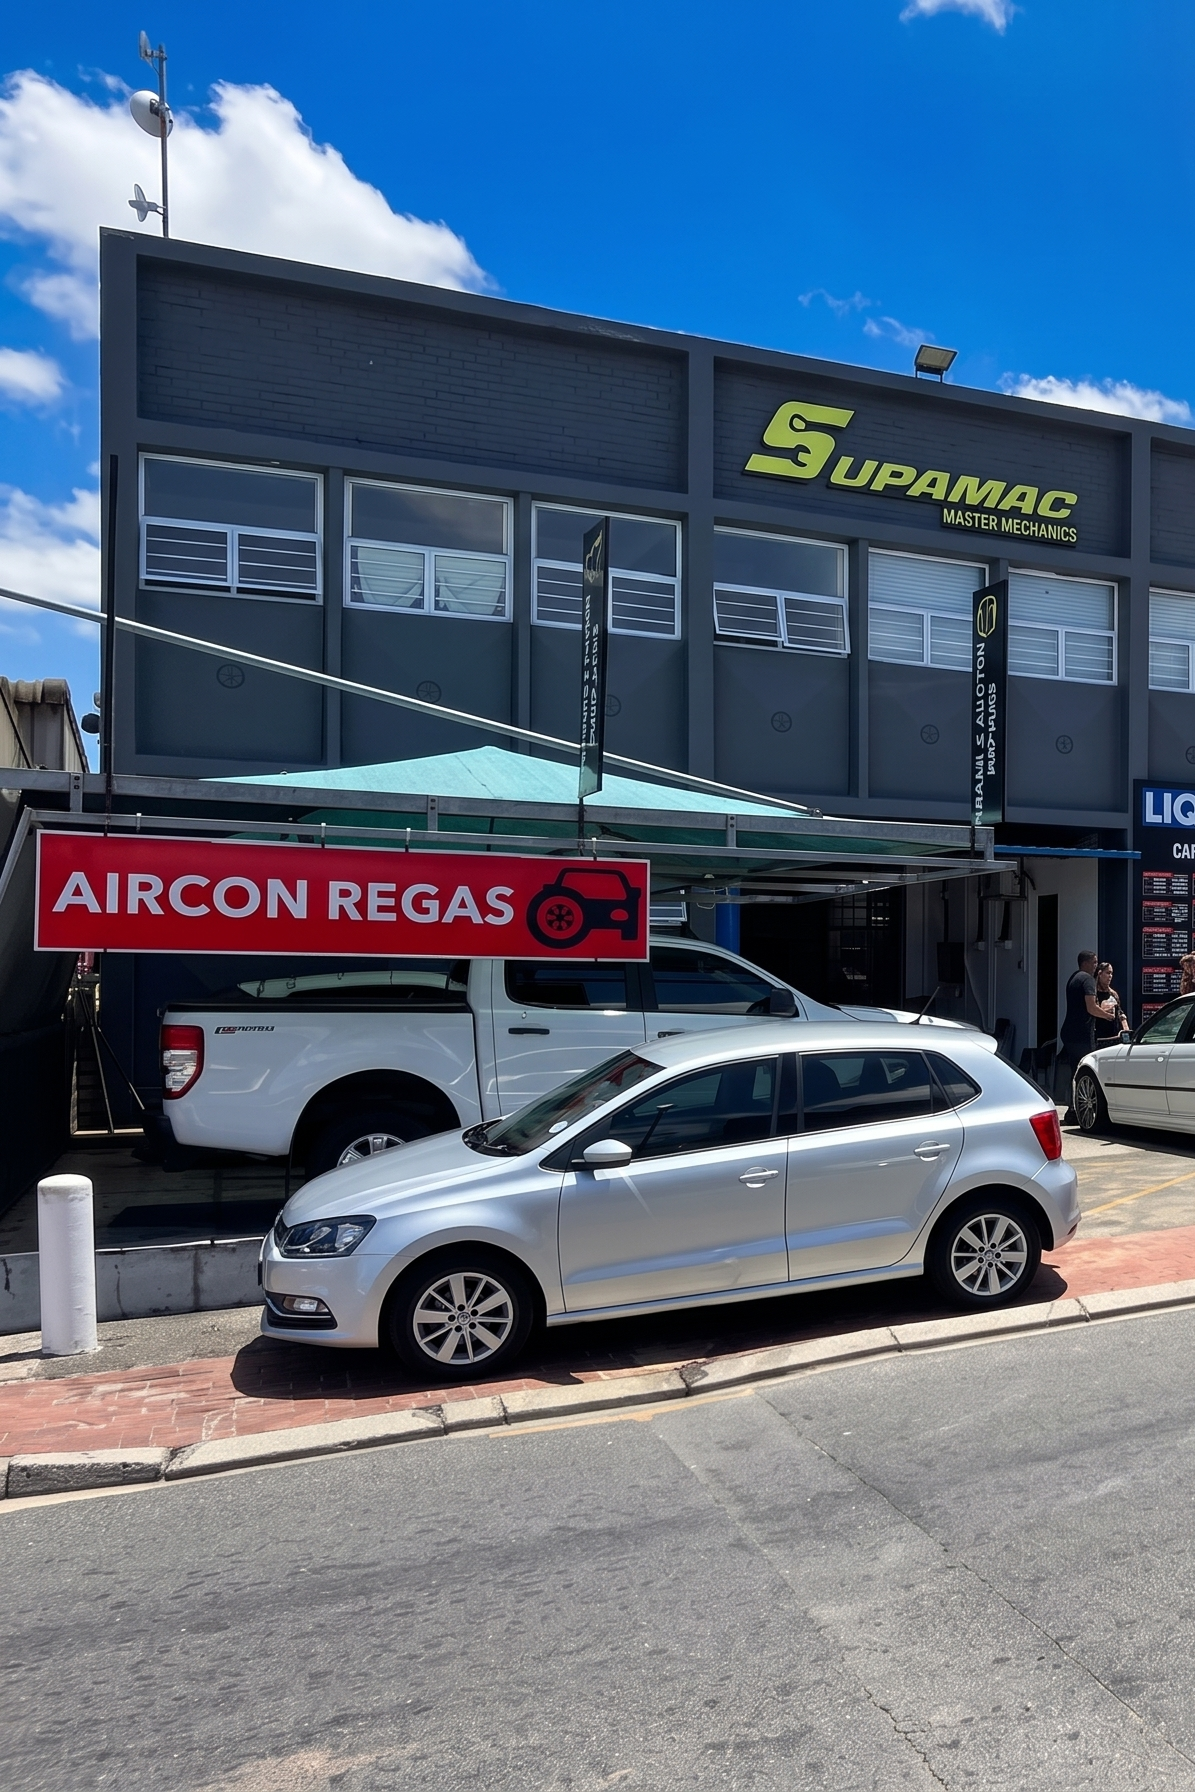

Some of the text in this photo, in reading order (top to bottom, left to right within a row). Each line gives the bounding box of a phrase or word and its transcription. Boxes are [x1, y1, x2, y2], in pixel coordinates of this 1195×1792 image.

[745, 401, 1078, 519] SUPAMAC
[943, 508, 1077, 543] MASTER MECHANICS
[52, 871, 515, 926] AIRCON REGAS
